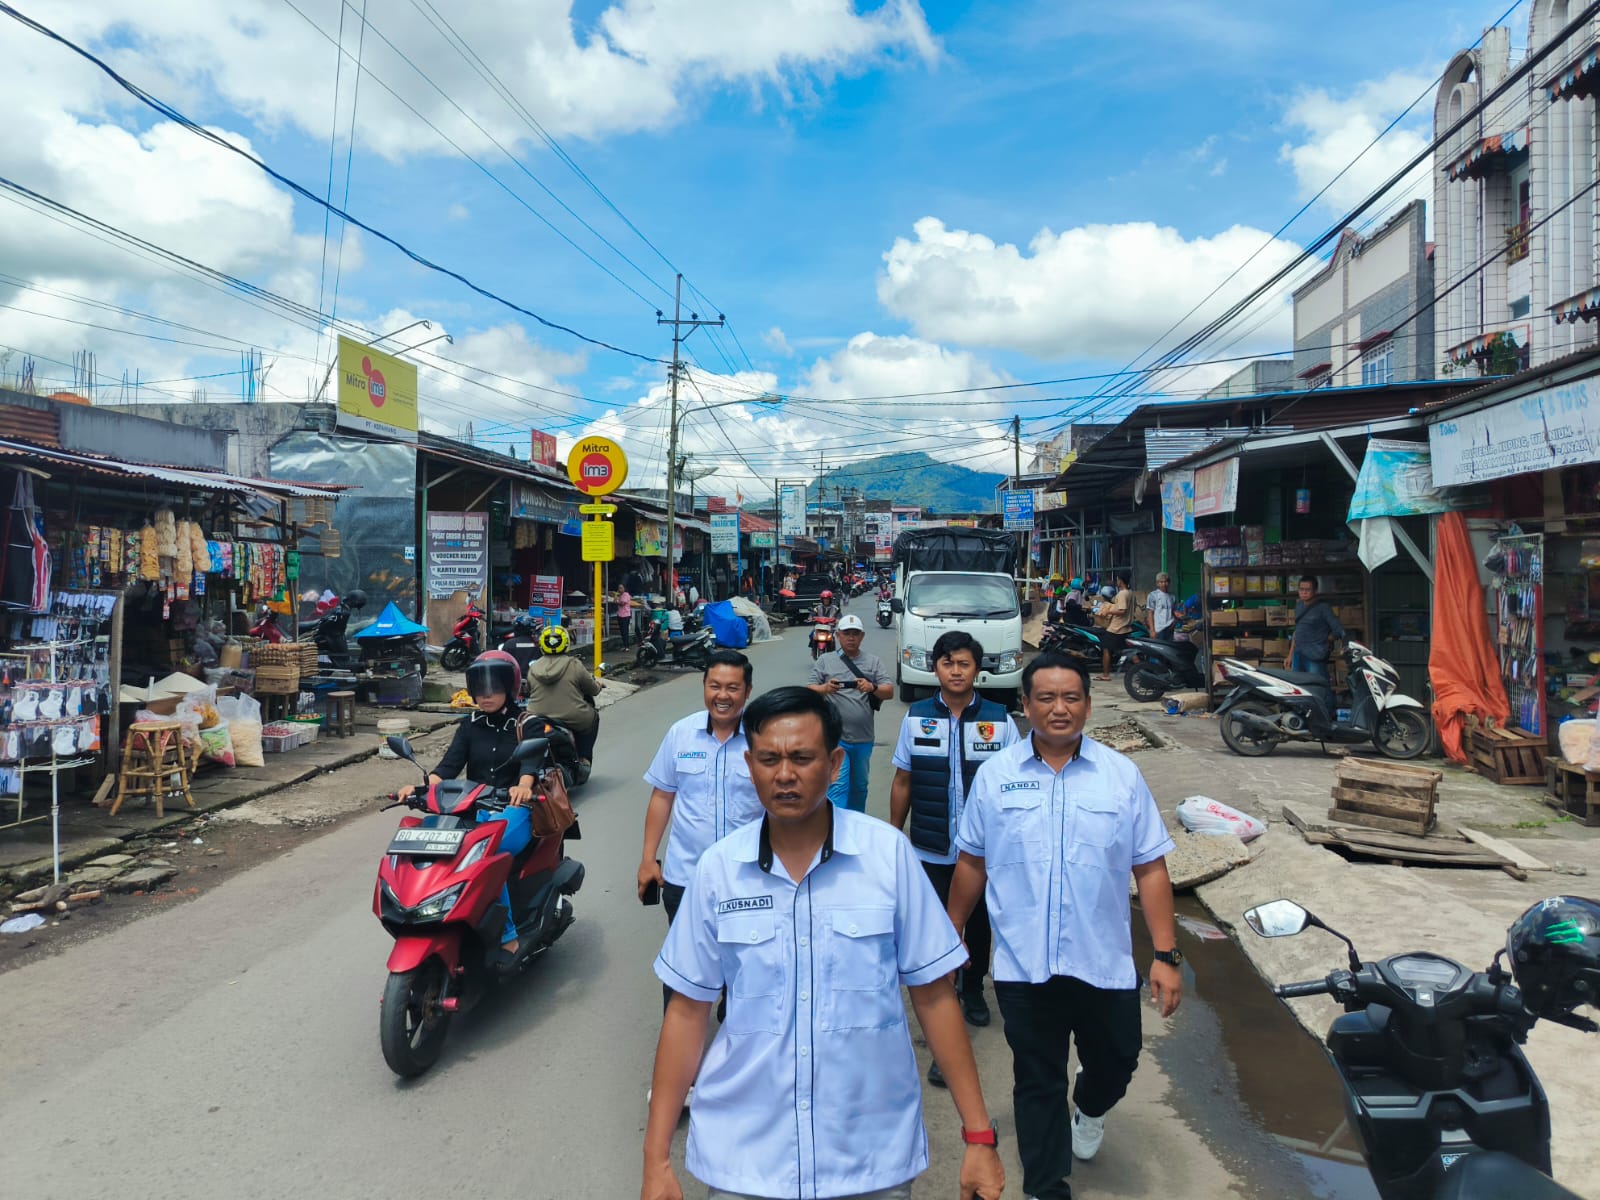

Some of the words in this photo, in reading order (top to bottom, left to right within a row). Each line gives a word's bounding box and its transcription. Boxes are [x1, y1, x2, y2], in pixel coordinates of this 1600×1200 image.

[345, 373, 366, 390] Mitra
[370, 381, 385, 398] im3
[1439, 422, 1458, 436] Toko
[582, 443, 610, 453] Mitra
[583, 462, 609, 477] im3
[1005, 782, 1036, 790] NANDA
